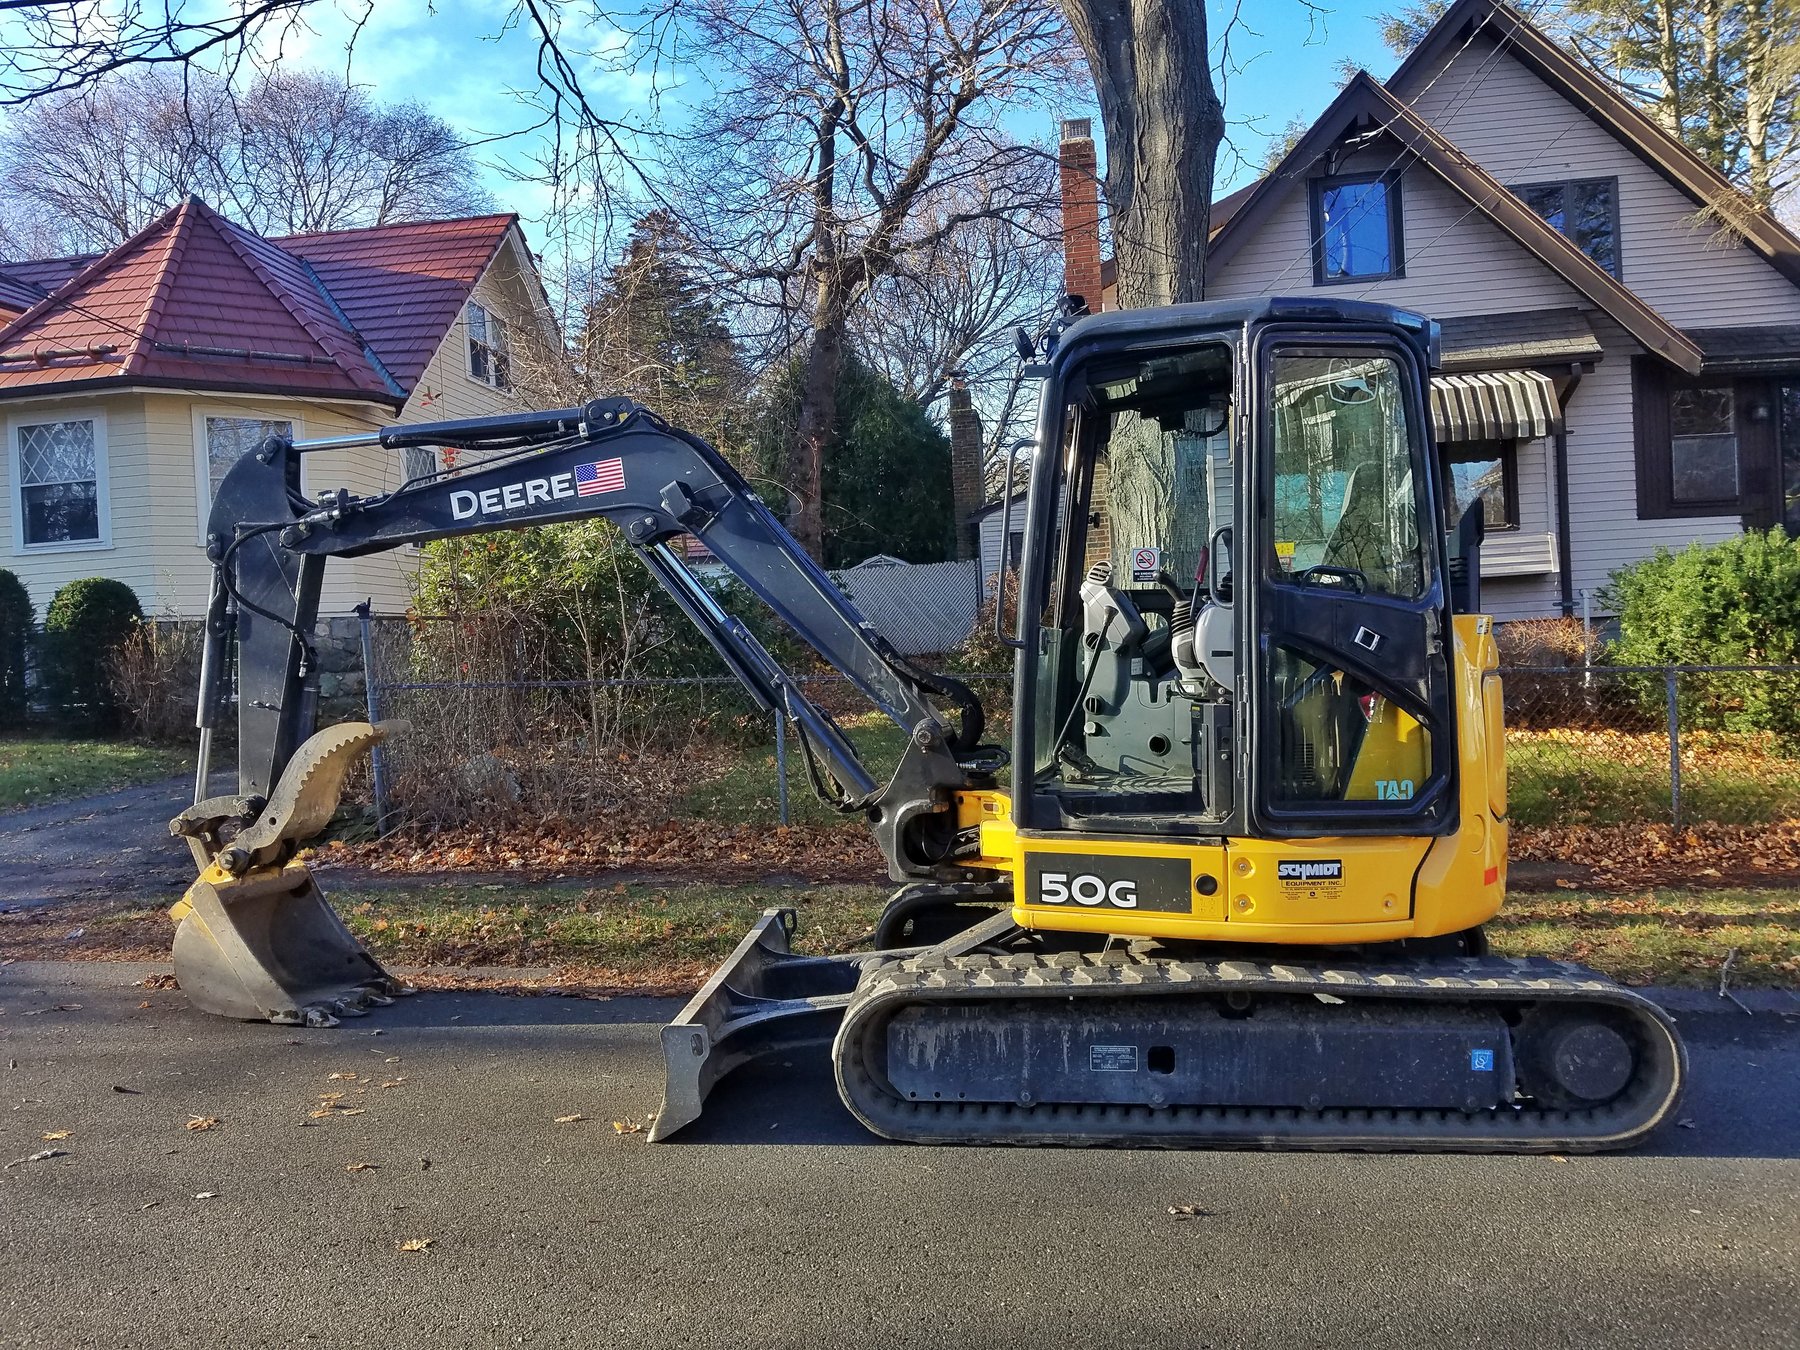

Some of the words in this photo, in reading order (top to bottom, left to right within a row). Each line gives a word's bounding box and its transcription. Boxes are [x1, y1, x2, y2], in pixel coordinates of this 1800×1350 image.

[450, 473, 575, 521] DEERE
[1278, 863, 1341, 880] SCHMIDT
[1041, 873, 1138, 908] 50G
